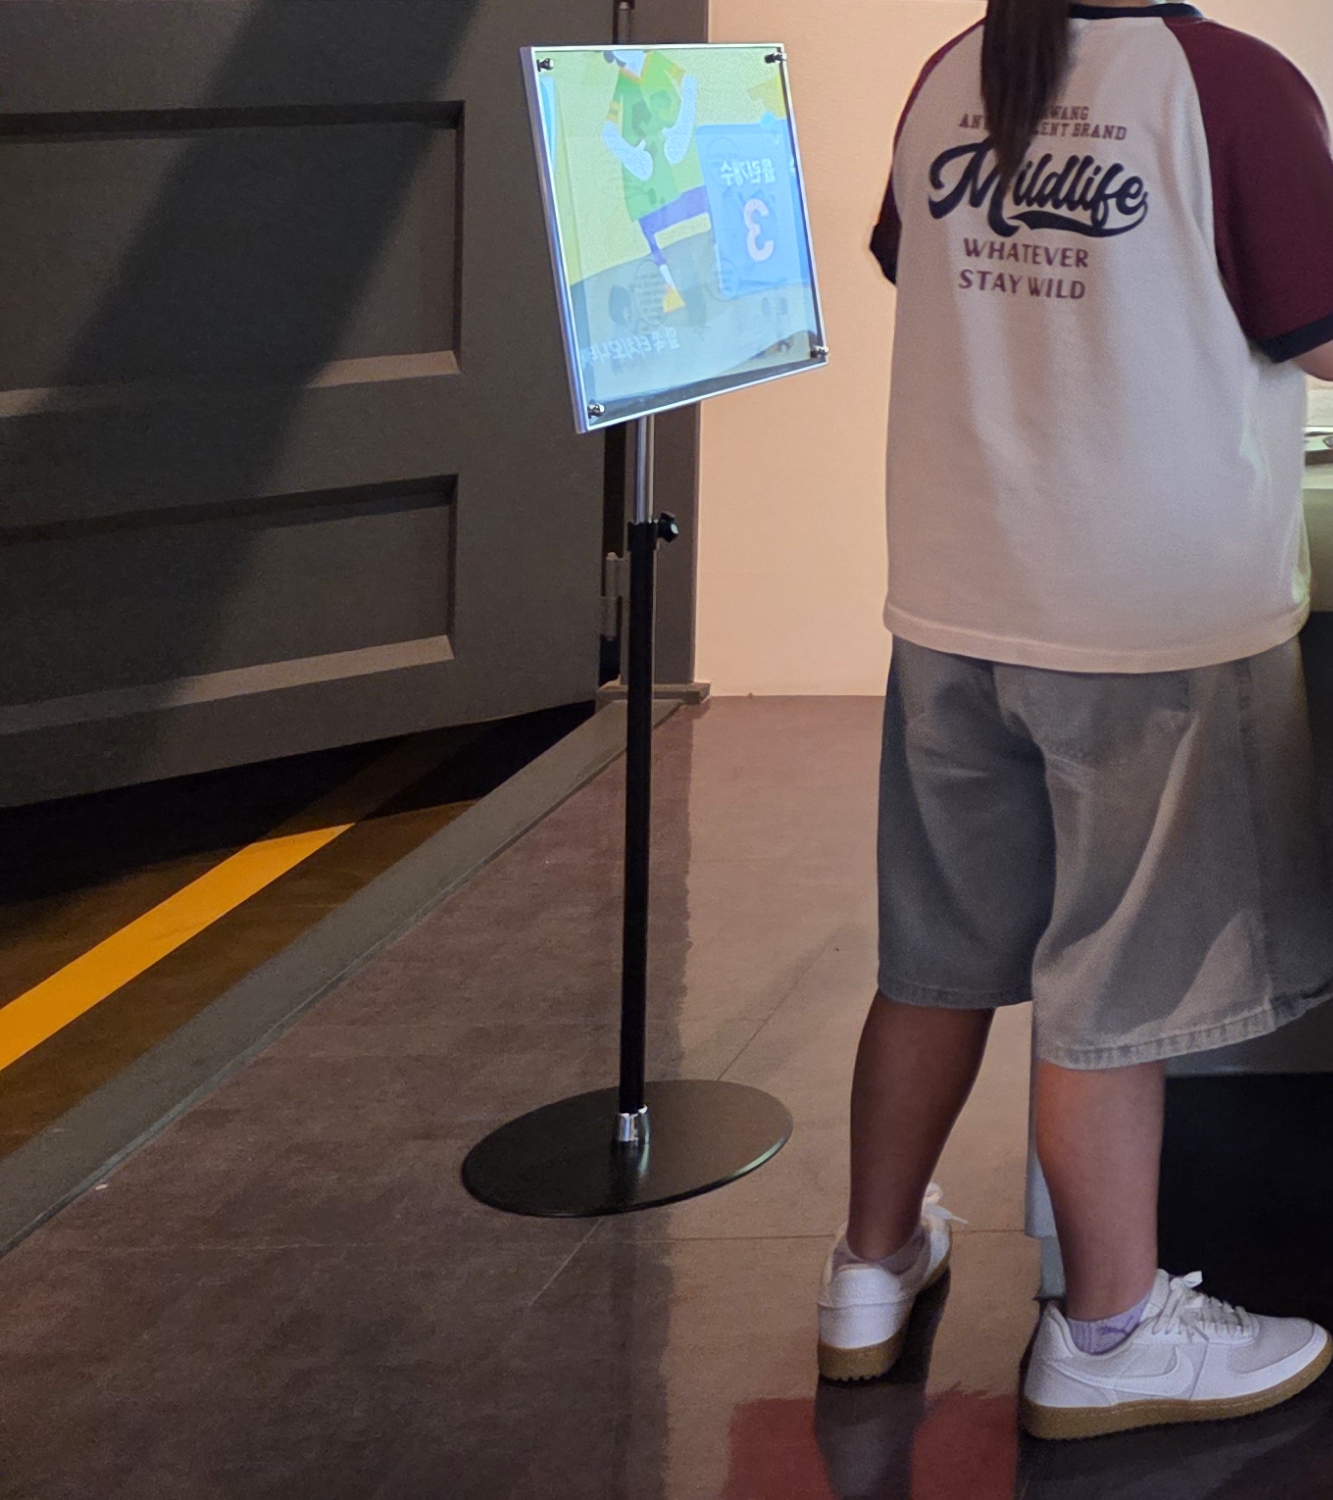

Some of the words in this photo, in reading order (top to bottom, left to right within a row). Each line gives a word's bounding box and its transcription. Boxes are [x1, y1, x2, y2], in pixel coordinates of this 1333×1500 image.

[1071, 122, 1128, 142] BRAND
[963, 237, 1090, 269] WHATEVER
[958, 268, 1022, 295] STAY
[1027, 275, 1087, 300] WILD
